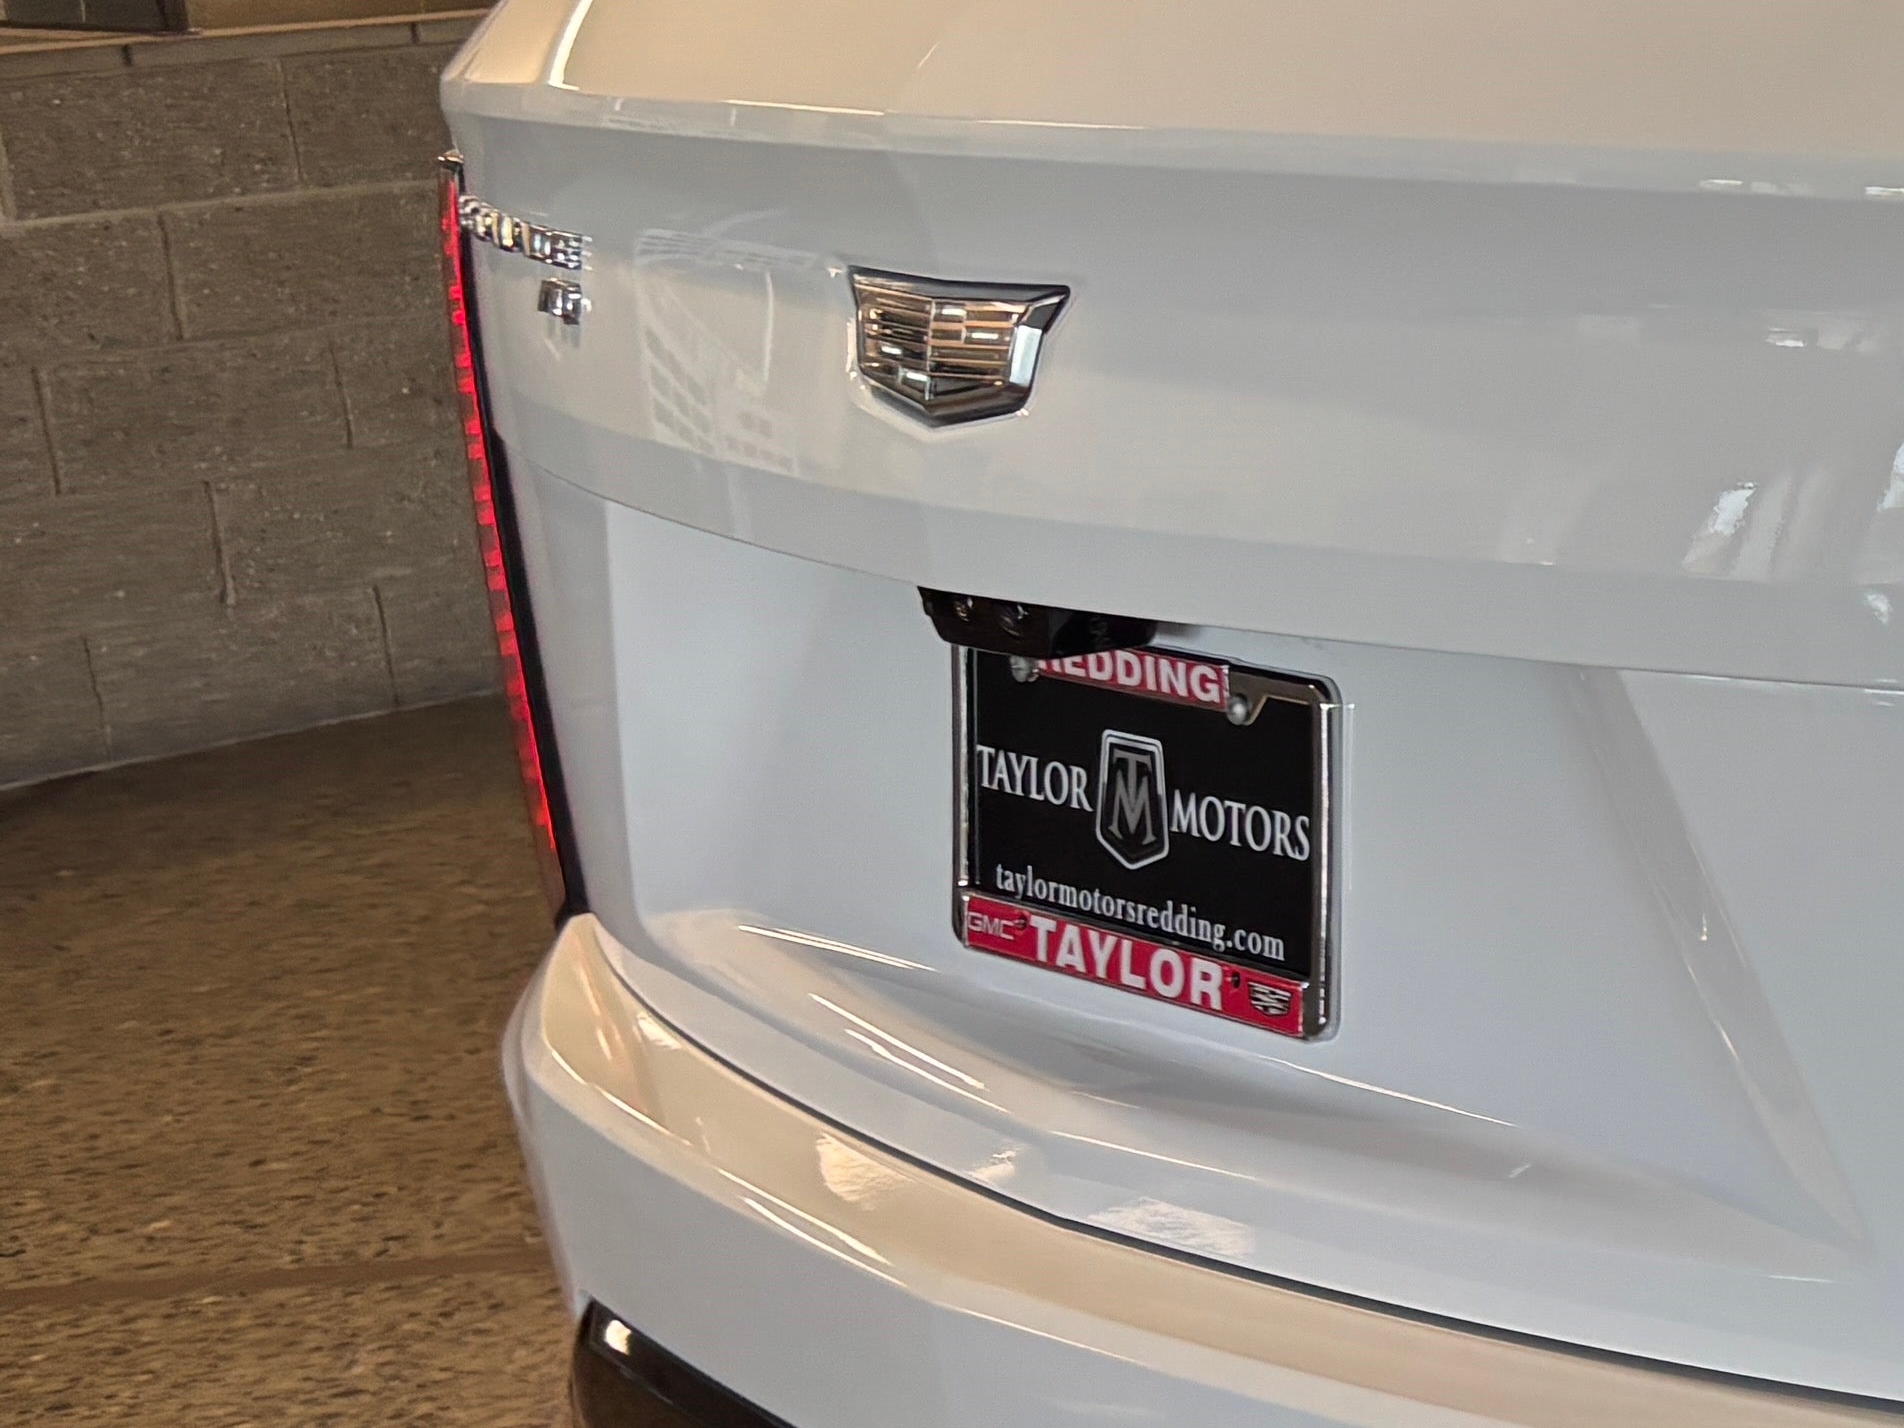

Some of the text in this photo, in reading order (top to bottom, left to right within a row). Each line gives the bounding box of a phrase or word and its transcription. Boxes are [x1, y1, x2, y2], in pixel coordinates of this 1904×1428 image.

[976, 743, 1311, 862] TAYLOR MOTORS
[995, 863, 1286, 962] taylormotorsredding.com
[1027, 914, 1224, 1012] TAYLOR
